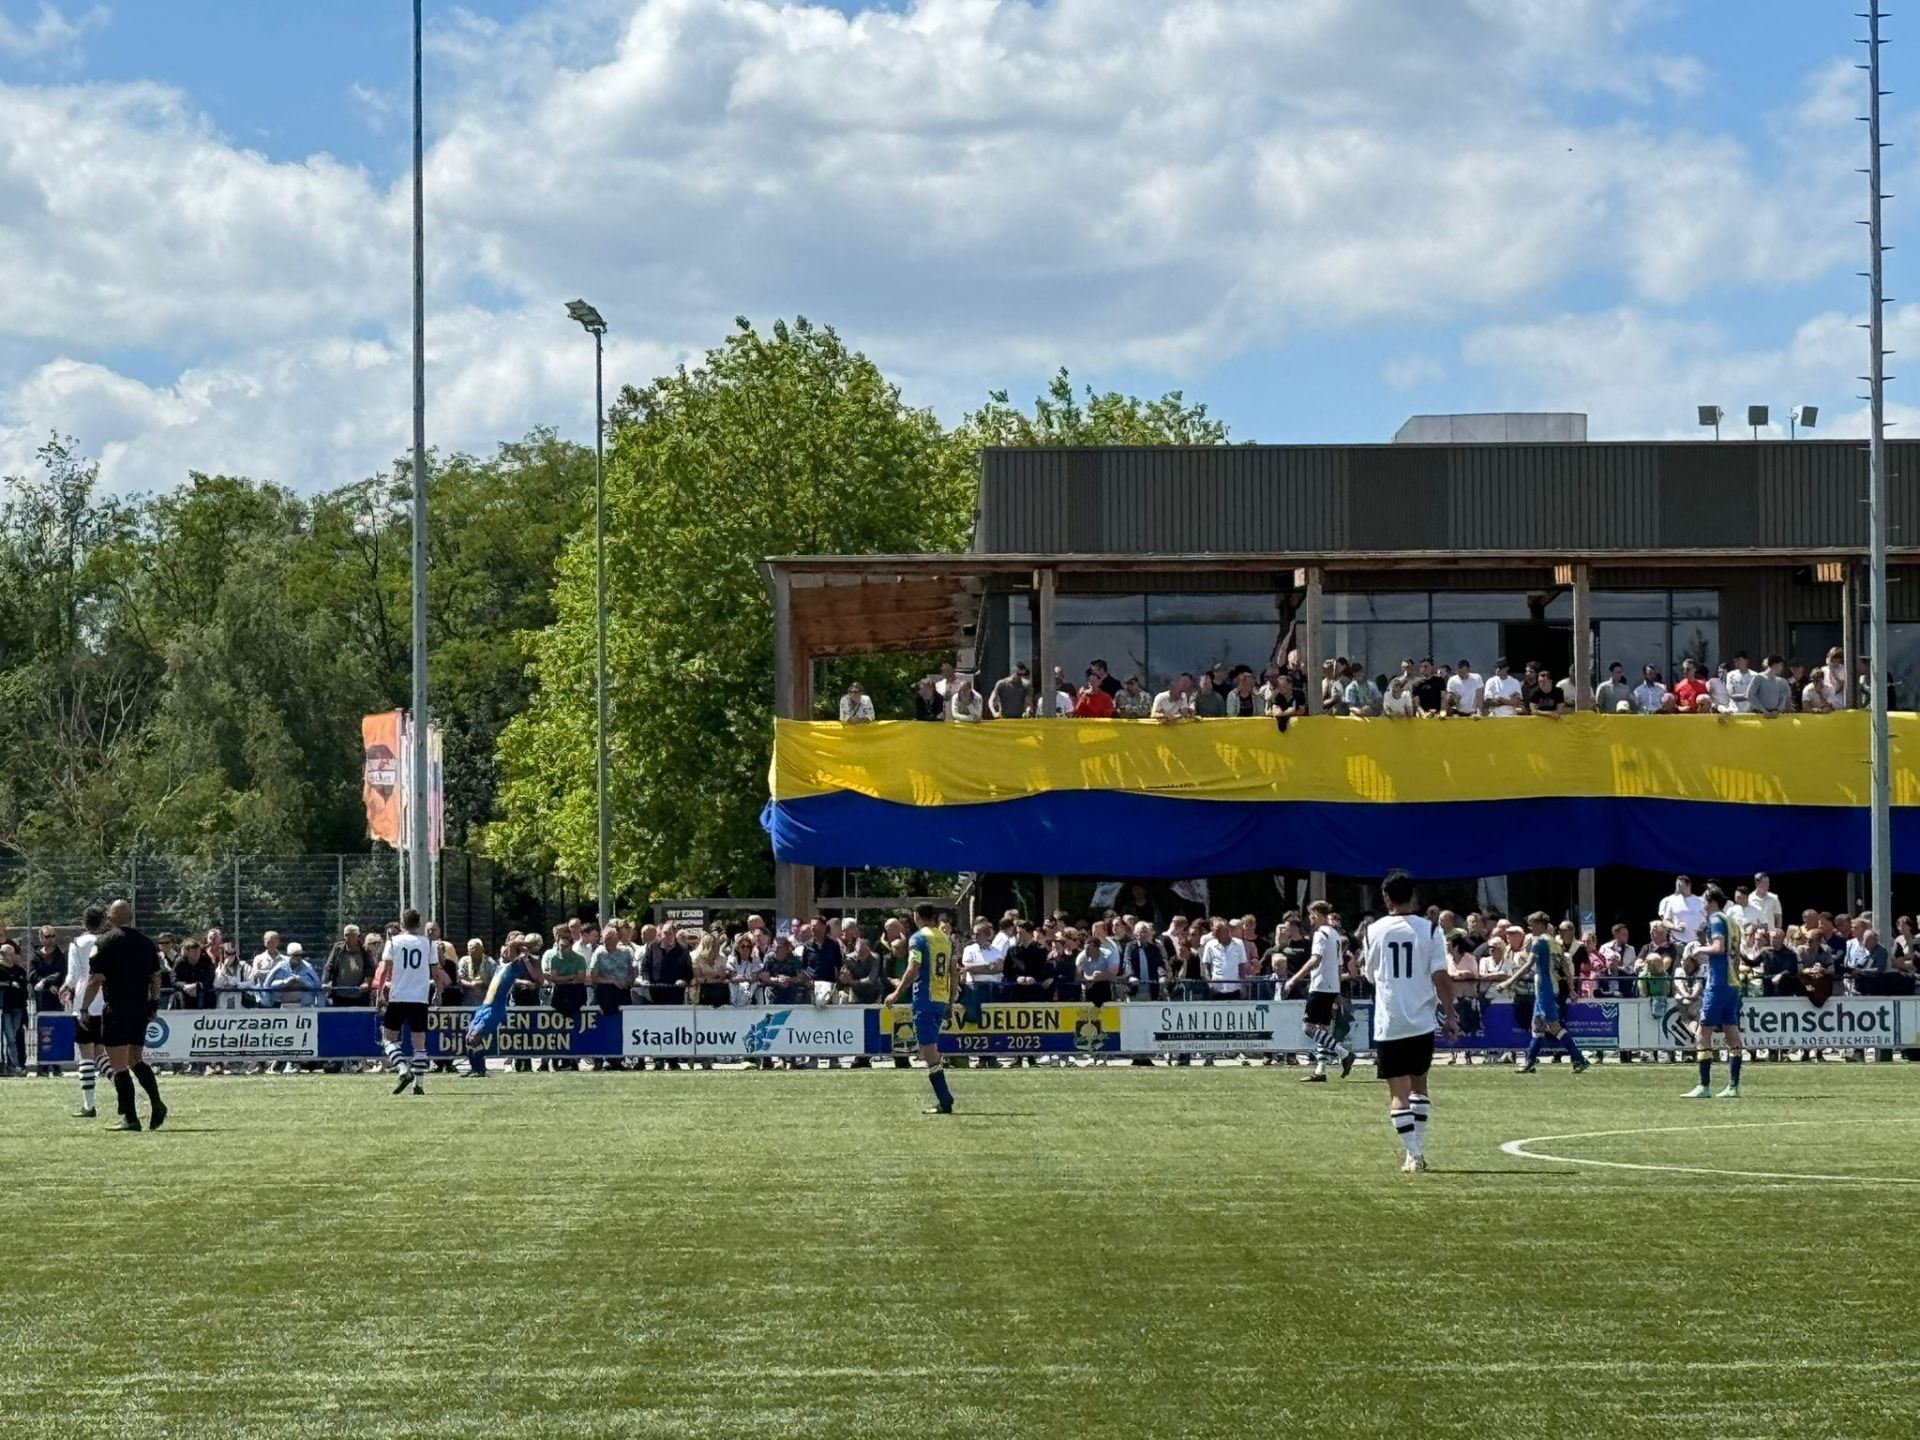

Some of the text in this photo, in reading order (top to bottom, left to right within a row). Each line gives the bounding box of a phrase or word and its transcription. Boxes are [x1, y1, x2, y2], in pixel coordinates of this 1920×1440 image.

[402, 946, 422, 970] 10
[935, 952, 946, 977] 8
[1388, 941, 1413, 979] 11
[193, 1015, 288, 1031] duurzaam
[537, 1012, 575, 1029] DOE
[578, 1012, 598, 1034] JE
[978, 1010, 1060, 1030] DELDEN
[191, 1032, 295, 1049] installaties
[439, 1032, 464, 1055] bij
[499, 1033, 571, 1050] DELDEN
[631, 1027, 854, 1046] Staalbouw Twente
[956, 1036, 990, 1050] 1923
[1006, 1035, 1042, 1050] 2023
